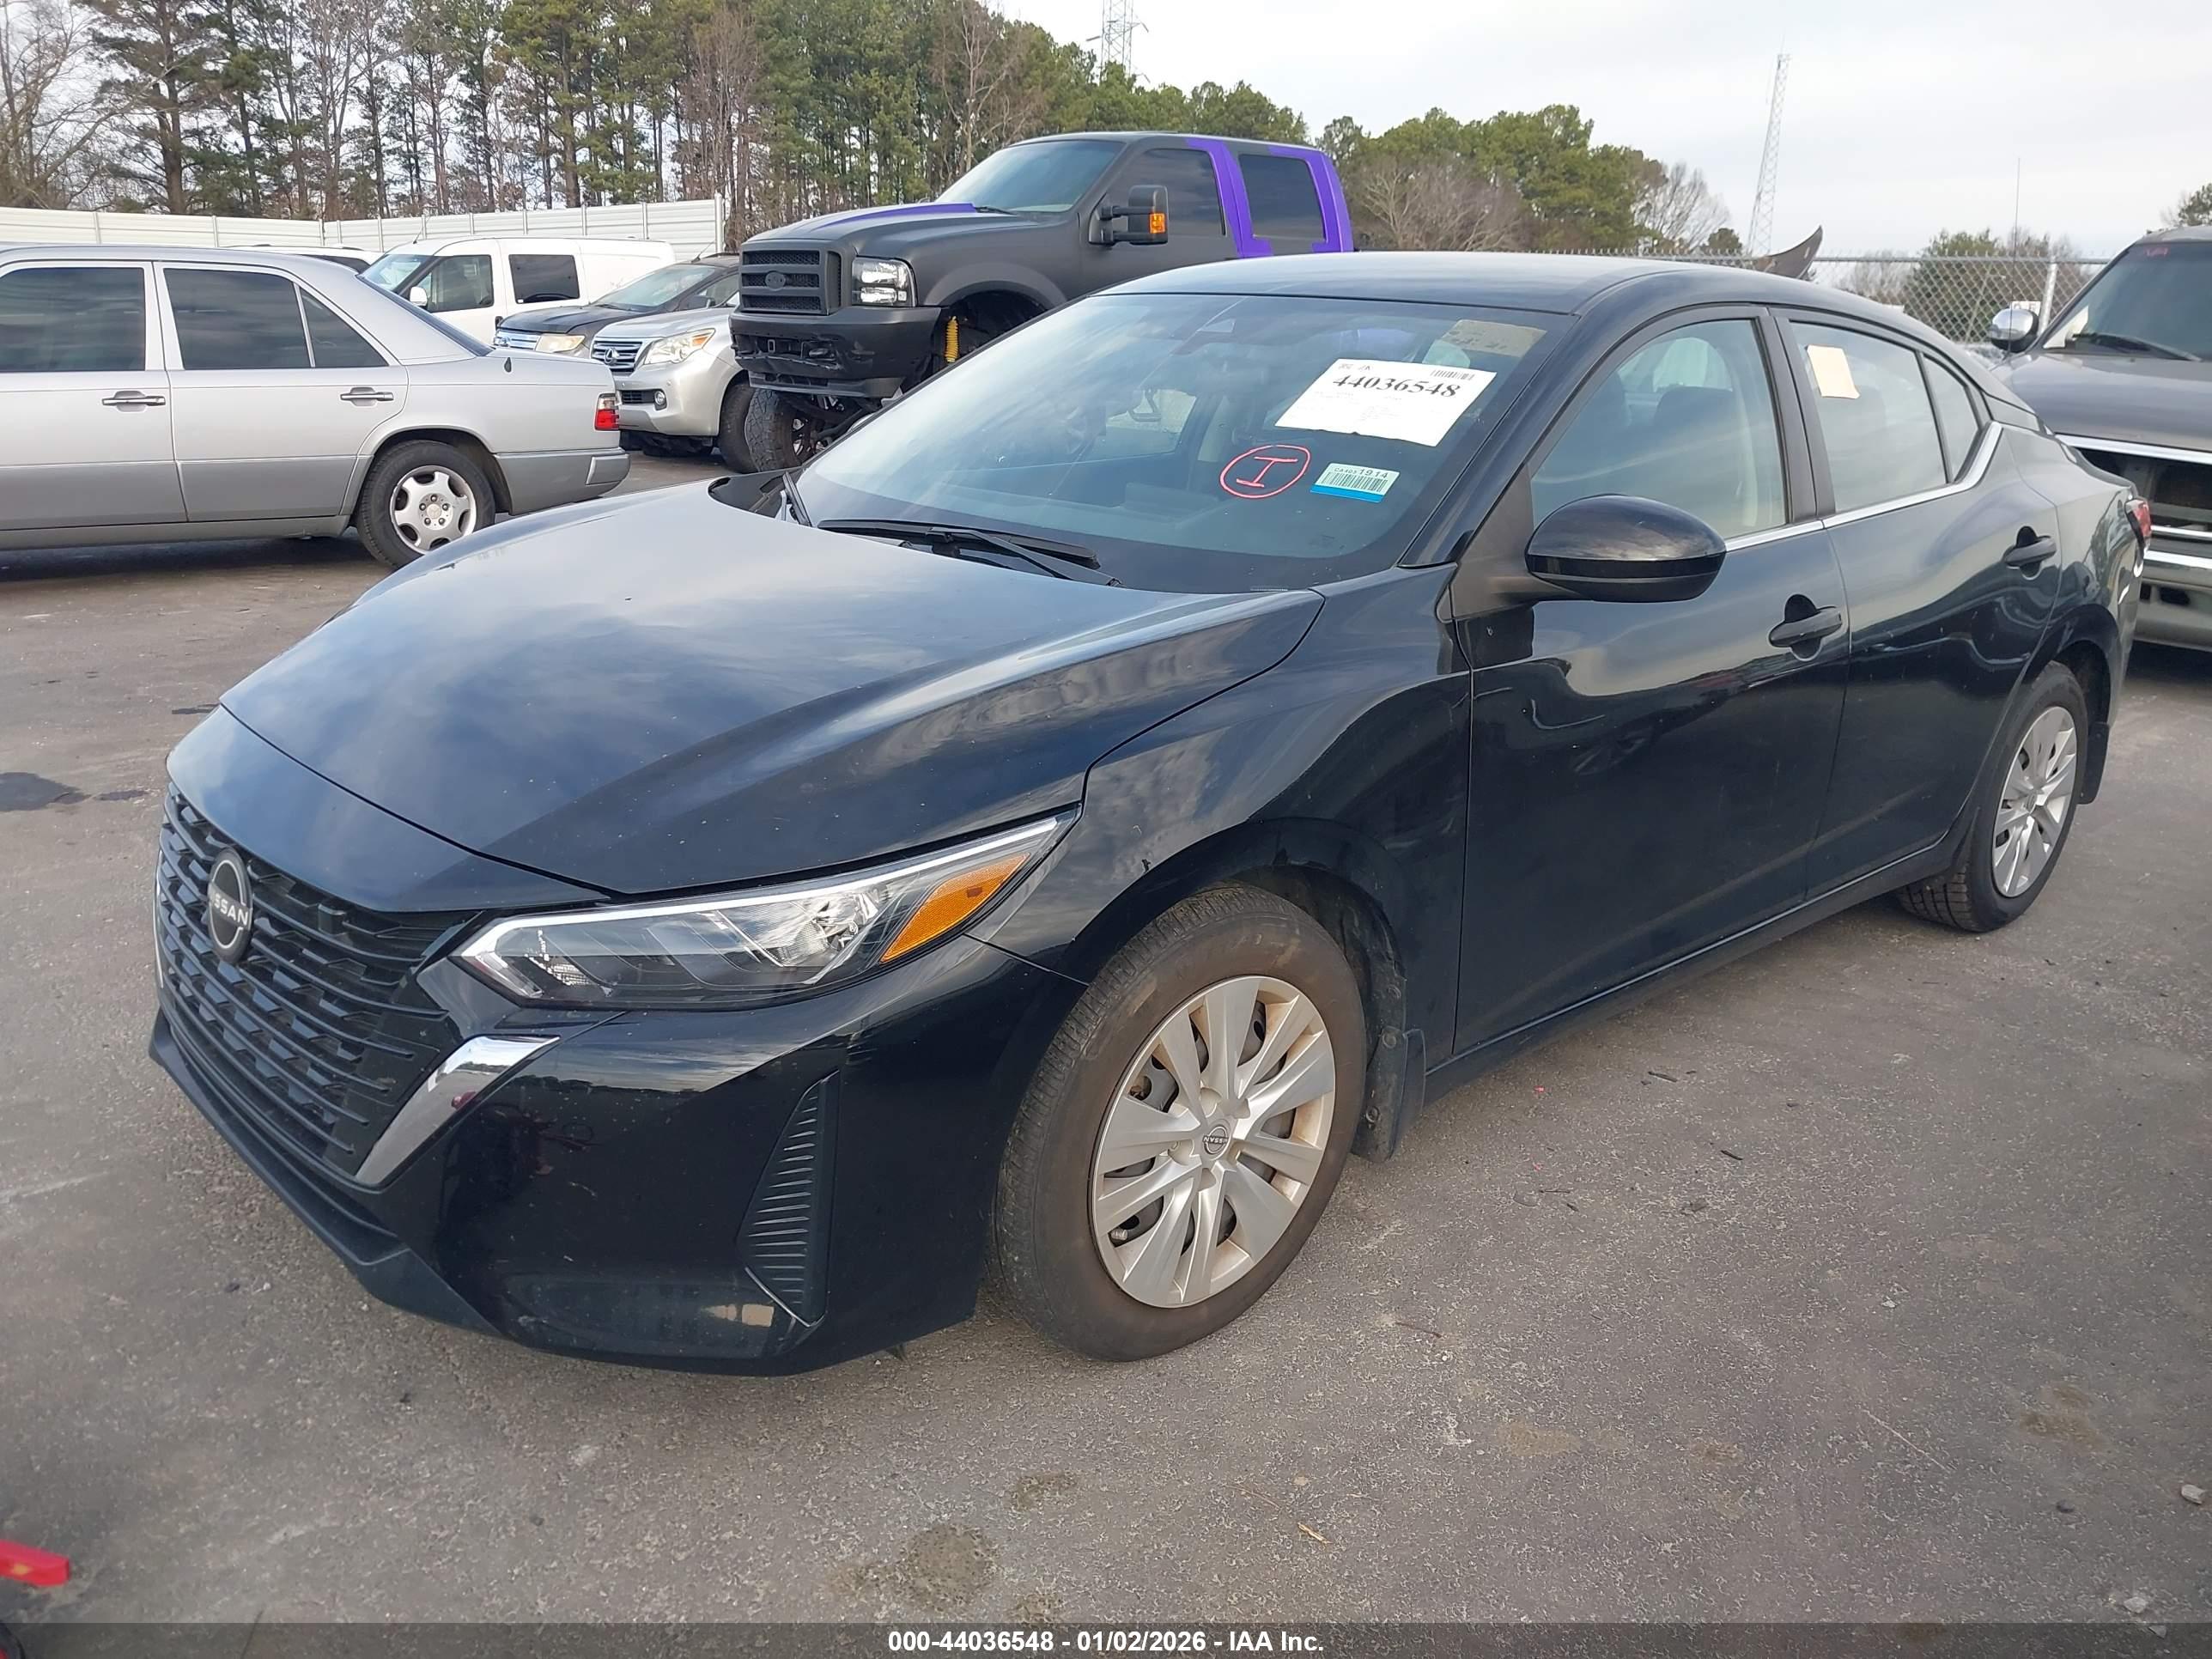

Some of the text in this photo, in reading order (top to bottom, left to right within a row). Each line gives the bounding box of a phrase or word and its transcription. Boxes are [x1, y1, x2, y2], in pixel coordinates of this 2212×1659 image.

[1333, 374, 1461, 398] 44036548
[1236, 456, 1298, 488] I
[1359, 468, 1389, 478] 1914
[212, 890, 249, 926] SSAN
